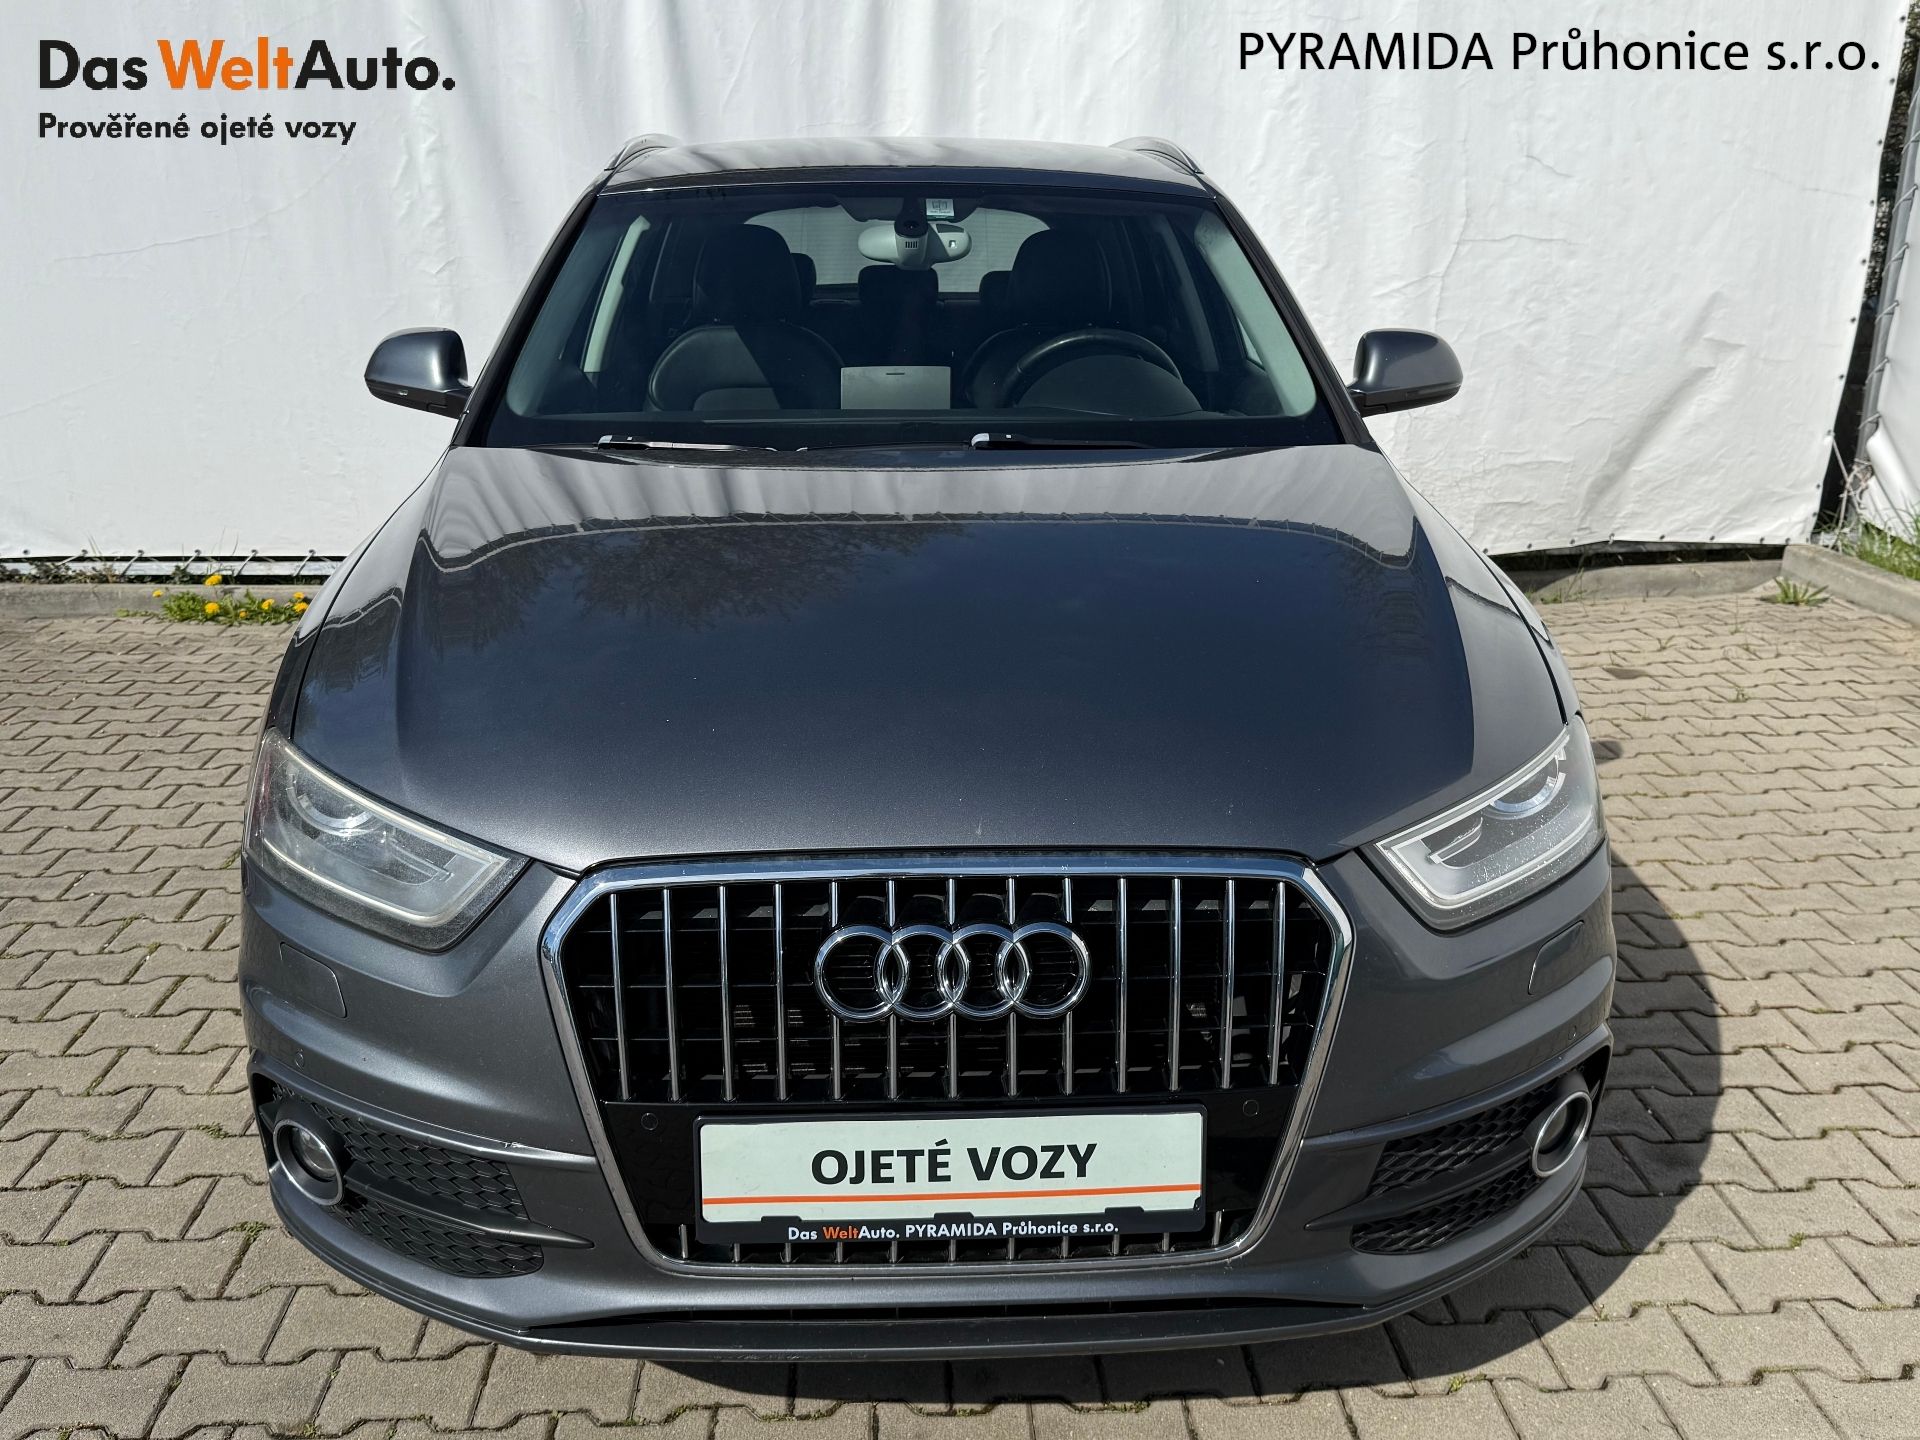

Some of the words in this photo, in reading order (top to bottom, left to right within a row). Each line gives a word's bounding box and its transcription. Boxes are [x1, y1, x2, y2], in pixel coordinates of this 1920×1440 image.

[811, 1138, 952, 1185] OJETÉ
[966, 1143, 1098, 1182] VOZY
[788, 1226, 818, 1240] Das
[822, 1224, 900, 1240] WeltAuto.
[905, 1222, 998, 1238] PYRAMIDA
[1002, 1220, 1078, 1236] Průhonice
[1082, 1222, 1119, 1234] s.r.o.
